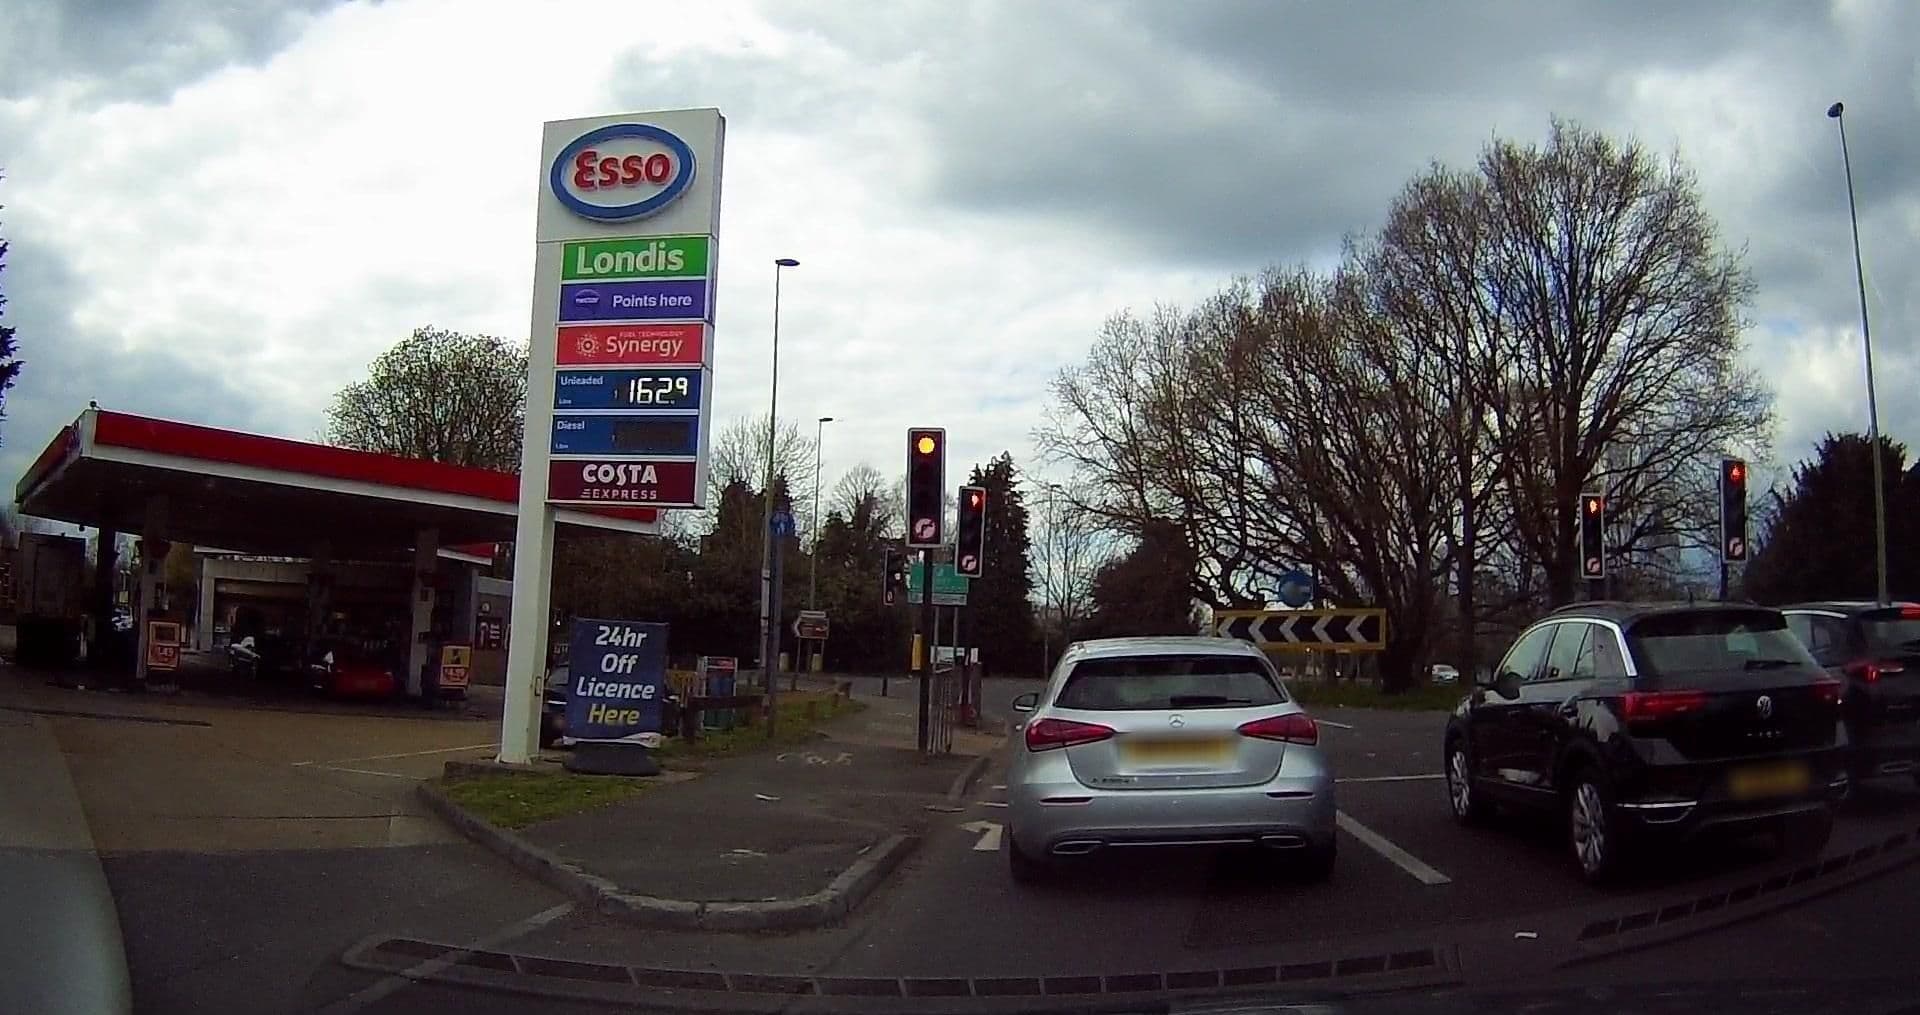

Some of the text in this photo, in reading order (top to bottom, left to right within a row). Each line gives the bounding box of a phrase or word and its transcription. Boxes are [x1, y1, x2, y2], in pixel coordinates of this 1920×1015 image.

[573, 150, 671, 189] Esso
[576, 241, 684, 275] Londis
[612, 293, 692, 308] Points here
[606, 336, 683, 357] Synergy
[560, 375, 604, 385] Unleaded
[557, 420, 585, 430] Diesel
[582, 463, 658, 486] COSTA
[592, 488, 657, 500] EXPRESS
[595, 624, 648, 648] 24hr
[601, 653, 639, 674] Off
[576, 676, 655, 699] Licence
[588, 703, 641, 725] Here
